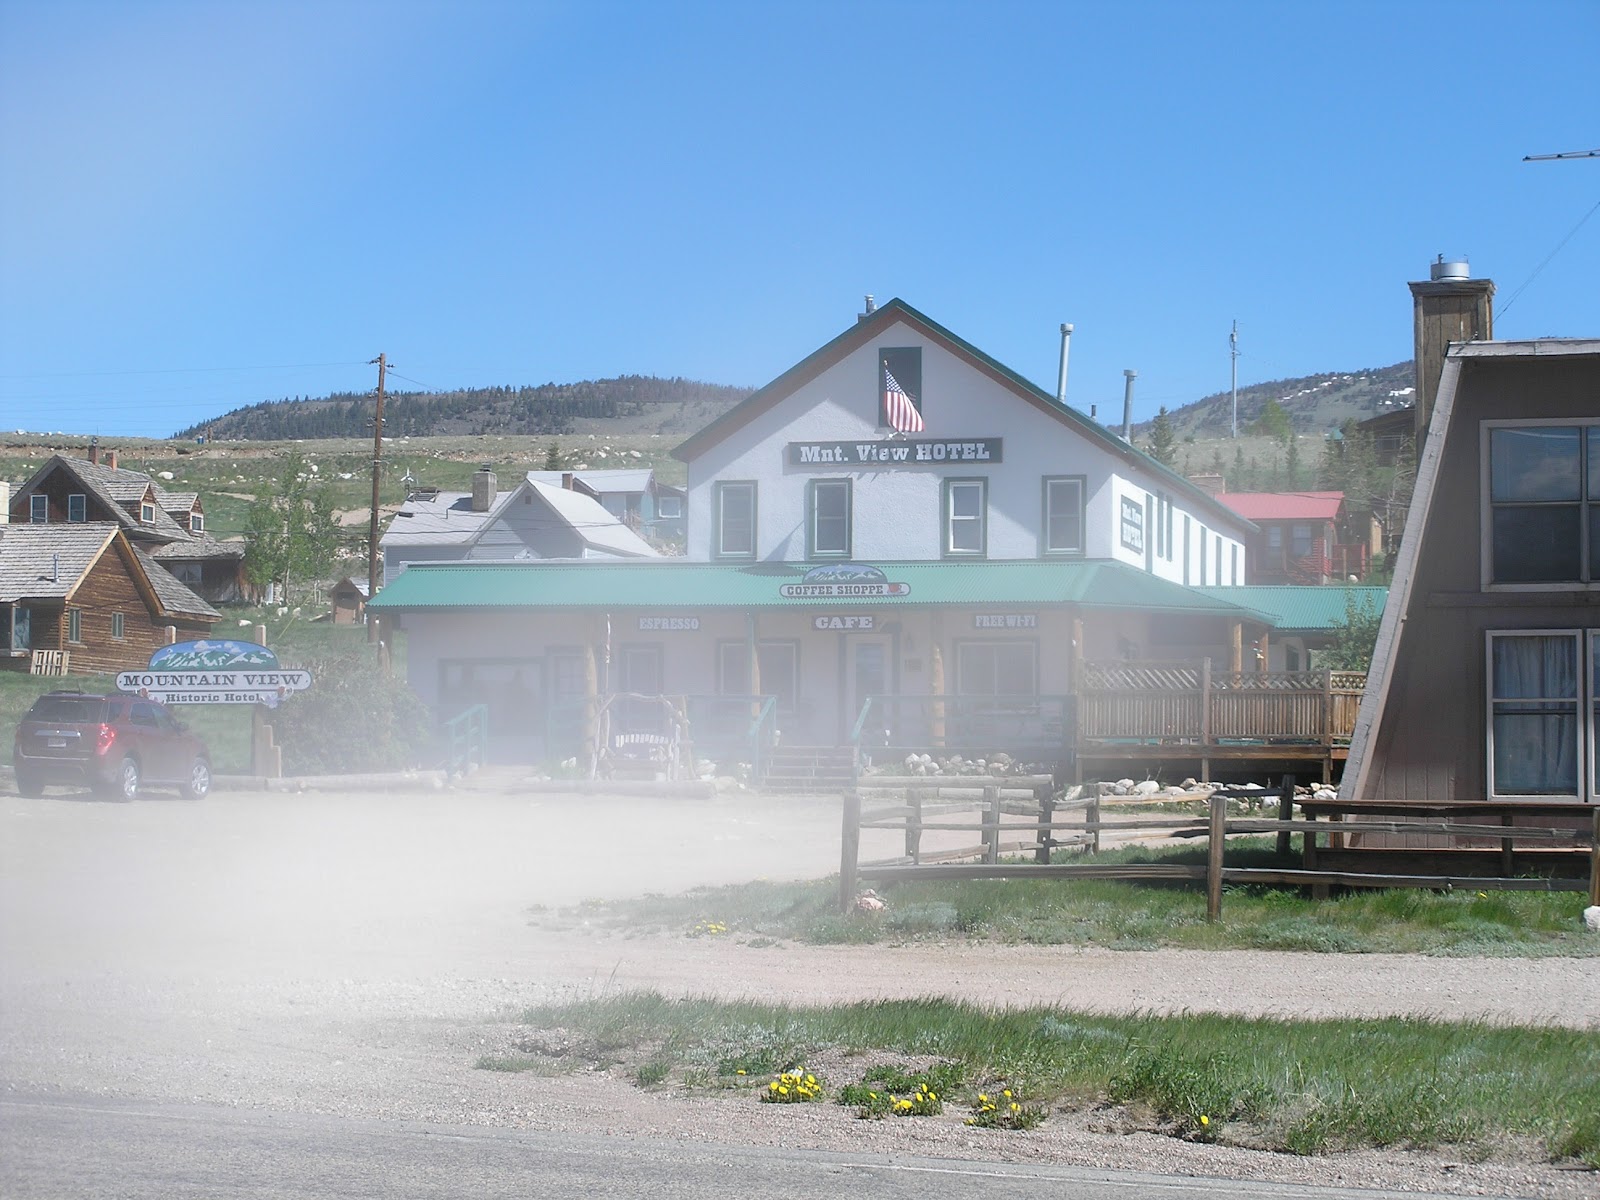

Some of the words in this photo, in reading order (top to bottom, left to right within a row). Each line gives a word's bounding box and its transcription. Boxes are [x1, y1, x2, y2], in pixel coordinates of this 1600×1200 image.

[800, 445, 848, 462] Mnt.
[856, 444, 909, 461] View
[916, 443, 990, 460] HOTEL
[787, 586, 833, 596] COFFEE
[837, 585, 884, 595] SHOPPE
[639, 617, 700, 630] ESPRESSO
[815, 616, 873, 629] CAFE
[975, 615, 1005, 627] FREE
[1006, 615, 1036, 627] WI-FI
[123, 674, 237, 686] MOUNTAIN
[243, 673, 303, 686] VIEW
[165, 693, 220, 703] Historic
[224, 693, 261, 703] Hotel
